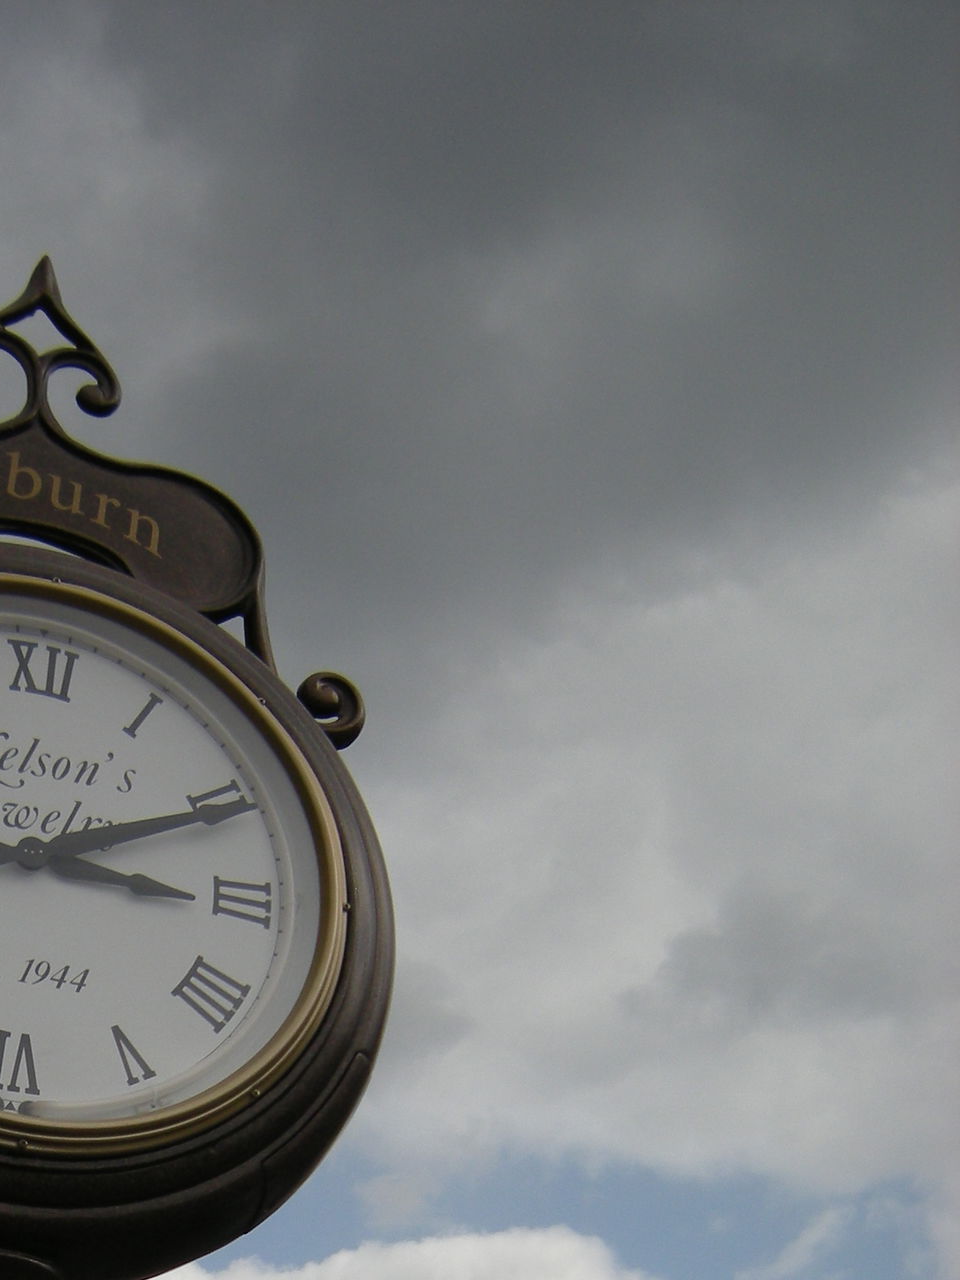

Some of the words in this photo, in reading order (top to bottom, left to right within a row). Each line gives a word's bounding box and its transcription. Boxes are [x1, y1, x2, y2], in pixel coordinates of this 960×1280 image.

[7, 639, 79, 702] XII
[122, 692, 163, 739] I
[212, 876, 272, 930] III
[18, 957, 91, 994] 1944
[110, 1023, 157, 1086] V
